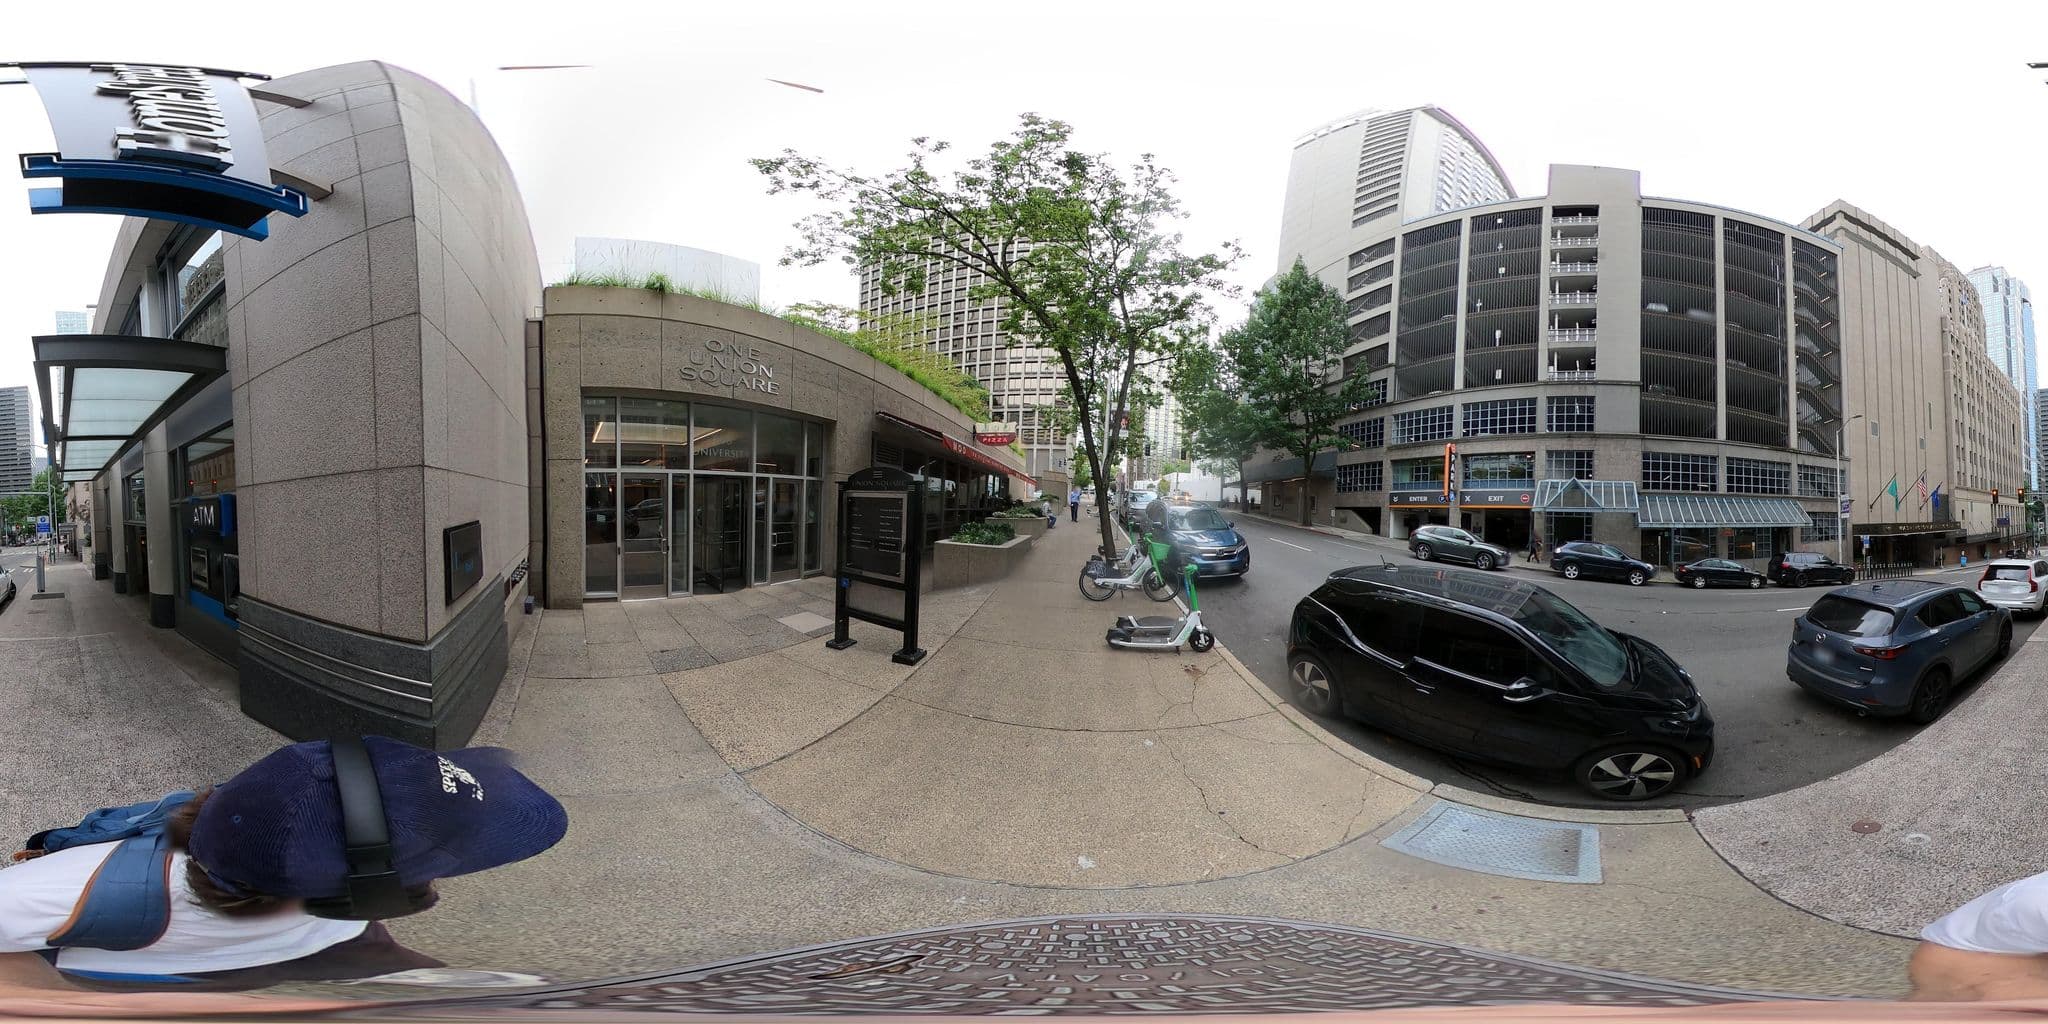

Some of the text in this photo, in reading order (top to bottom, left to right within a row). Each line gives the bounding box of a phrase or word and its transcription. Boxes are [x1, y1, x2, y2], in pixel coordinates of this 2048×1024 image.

[705, 340, 760, 362] ONE
[690, 350, 773, 379] UNION
[680, 366, 780, 396] SQUARE
[193, 505, 215, 526] ATM
